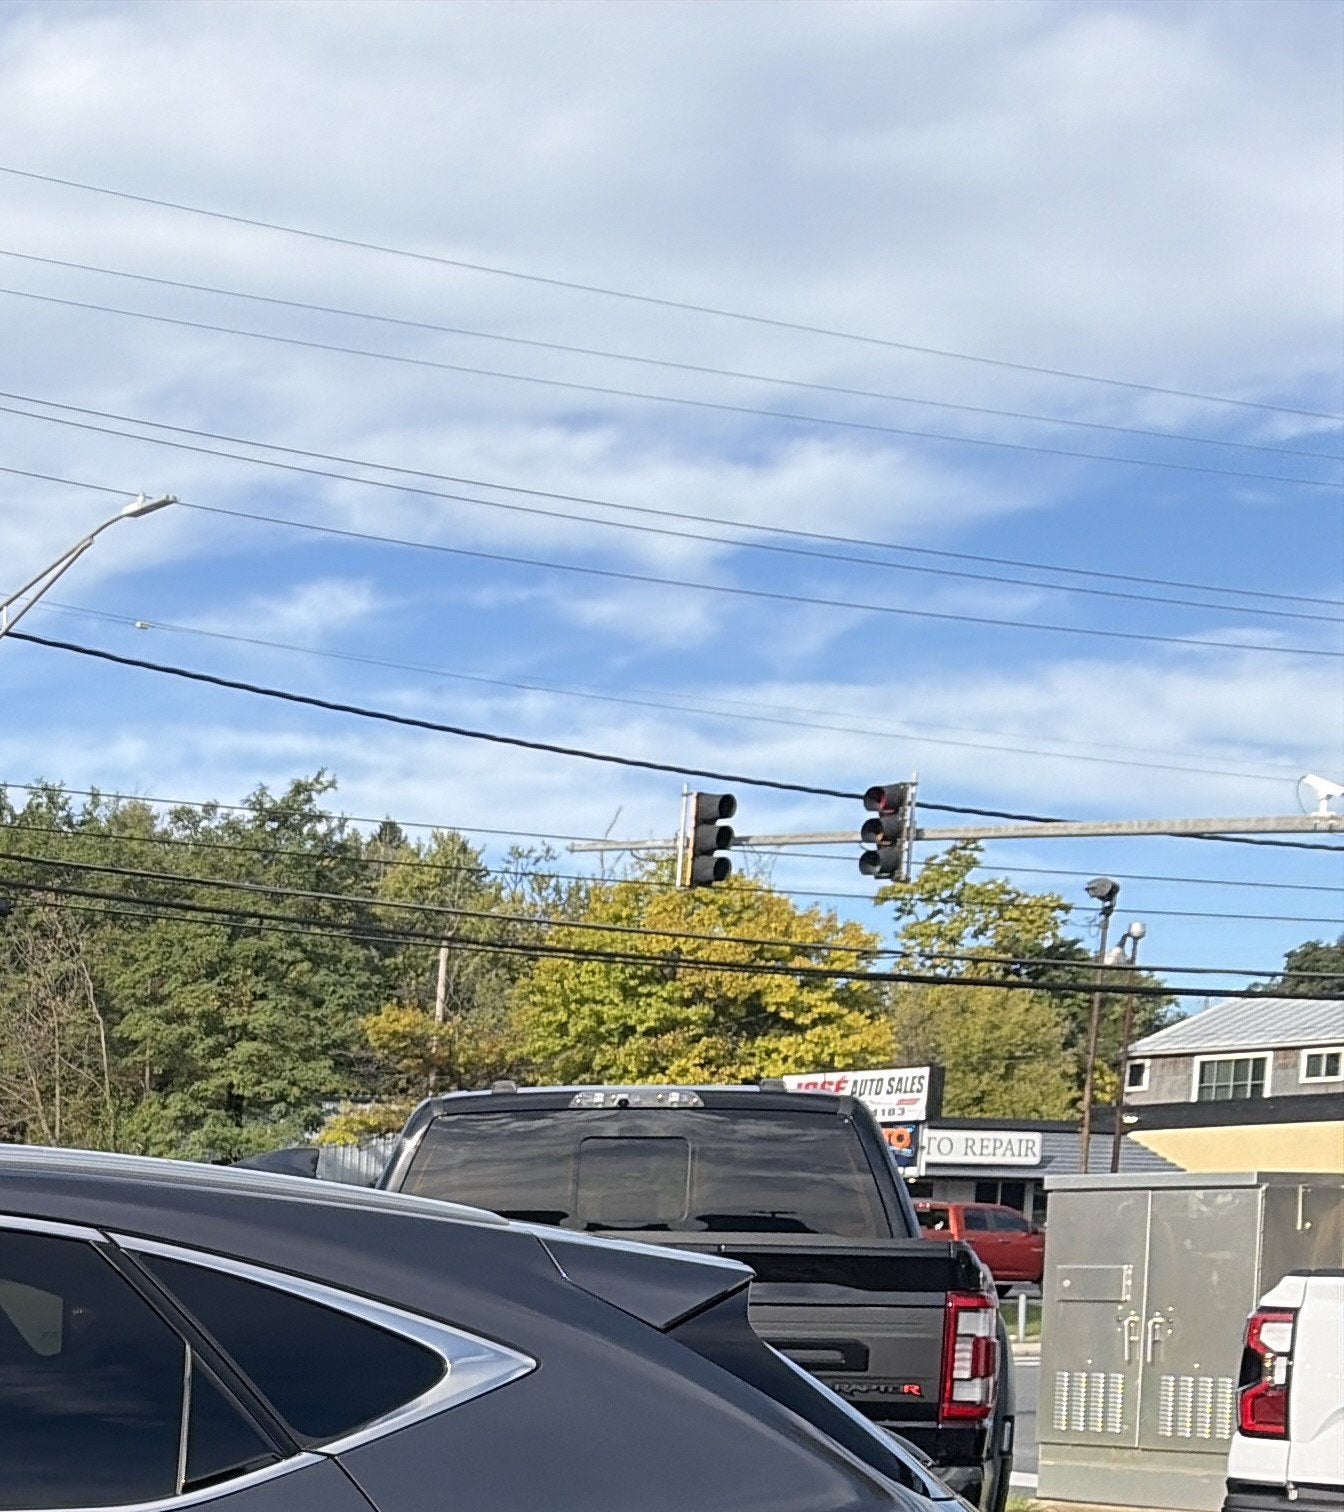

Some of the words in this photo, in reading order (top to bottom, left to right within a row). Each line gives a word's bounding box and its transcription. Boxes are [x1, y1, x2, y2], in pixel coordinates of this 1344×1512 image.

[851, 1078, 883, 1097] AUTO
[886, 1075, 926, 1095] SALES
[926, 1136, 954, 1156] TO
[963, 1137, 1038, 1158] REPAIR
